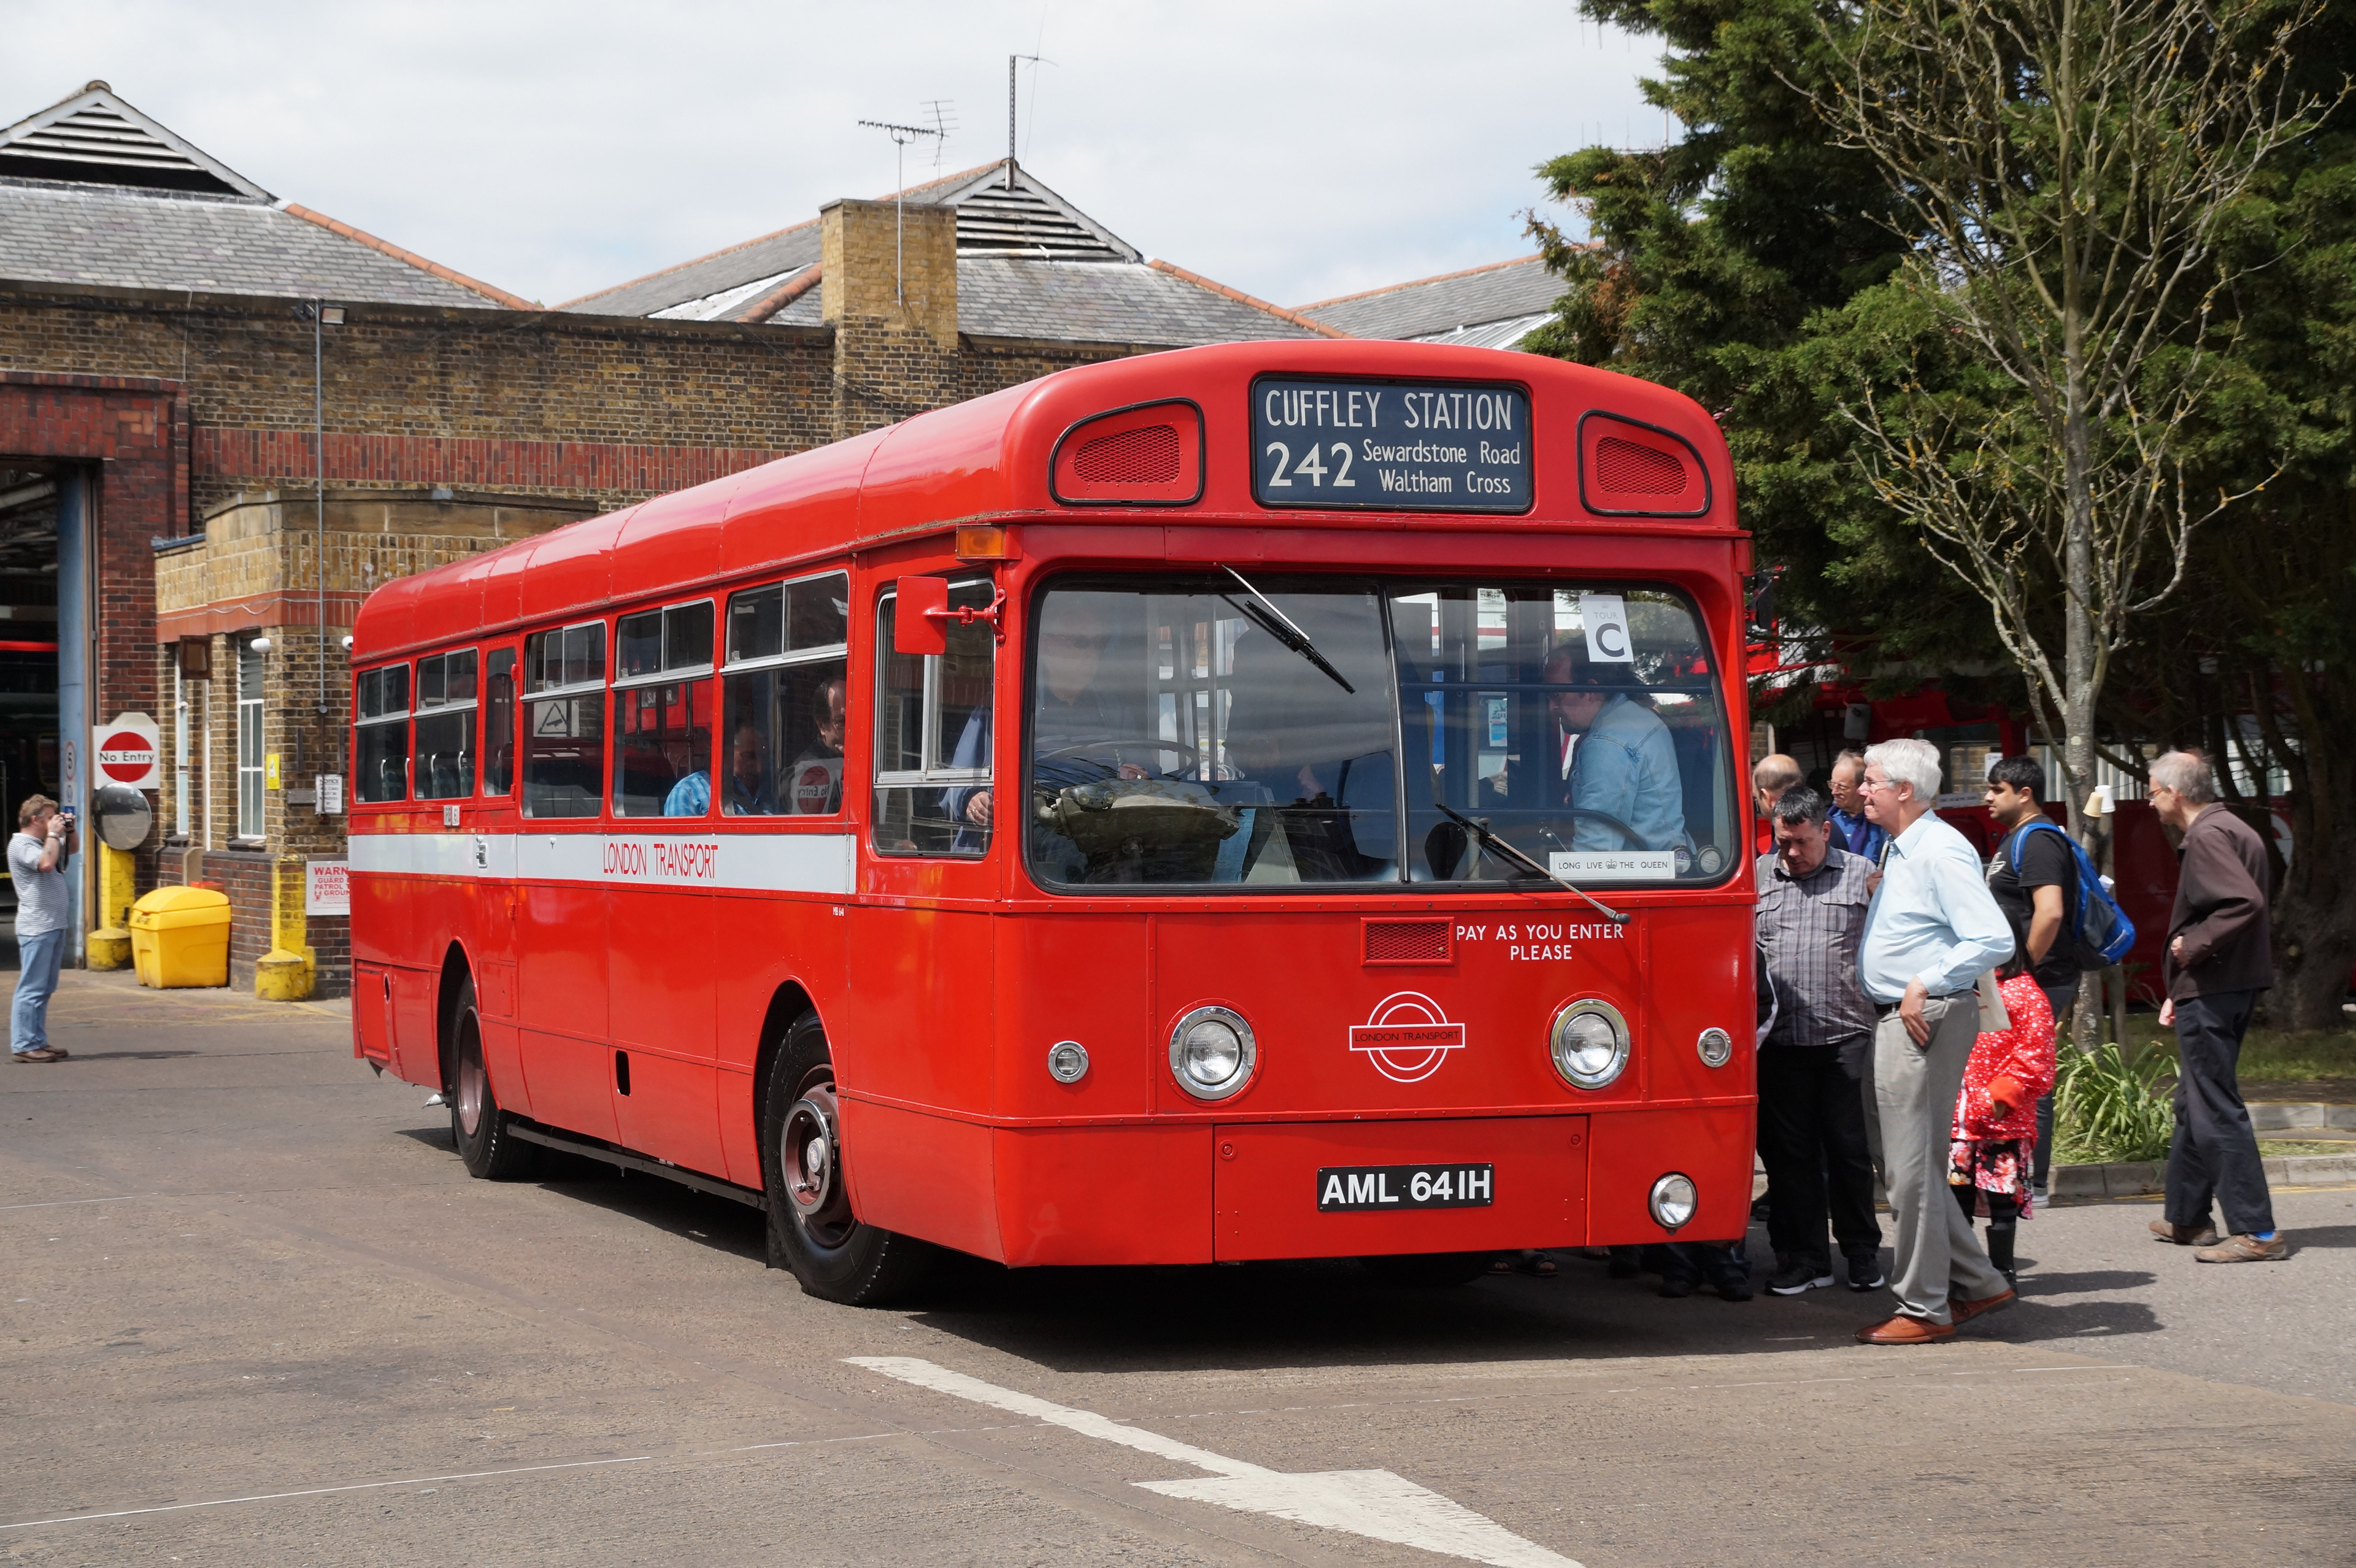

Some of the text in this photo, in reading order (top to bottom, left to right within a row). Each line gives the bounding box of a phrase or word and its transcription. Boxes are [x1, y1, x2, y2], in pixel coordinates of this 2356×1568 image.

[1265, 390, 1512, 431] CUFFLEY STATION
[1266, 442, 1356, 487] 242
[1363, 439, 1520, 465] Sewardstone Road
[1379, 469, 1511, 494] Waltham Cross
[1595, 623, 1625, 658] C
[68, 751, 73, 770] 5
[99, 751, 155, 764] No Entry
[603, 842, 718, 879] LONDON TRANSPORT
[1457, 924, 1624, 940] PAY AS YOU ENTER
[1510, 945, 1572, 961] PLEASE
[1355, 1031, 1459, 1042] LONDON TRANSPORT
[1322, 1170, 1490, 1204] AML 641H
